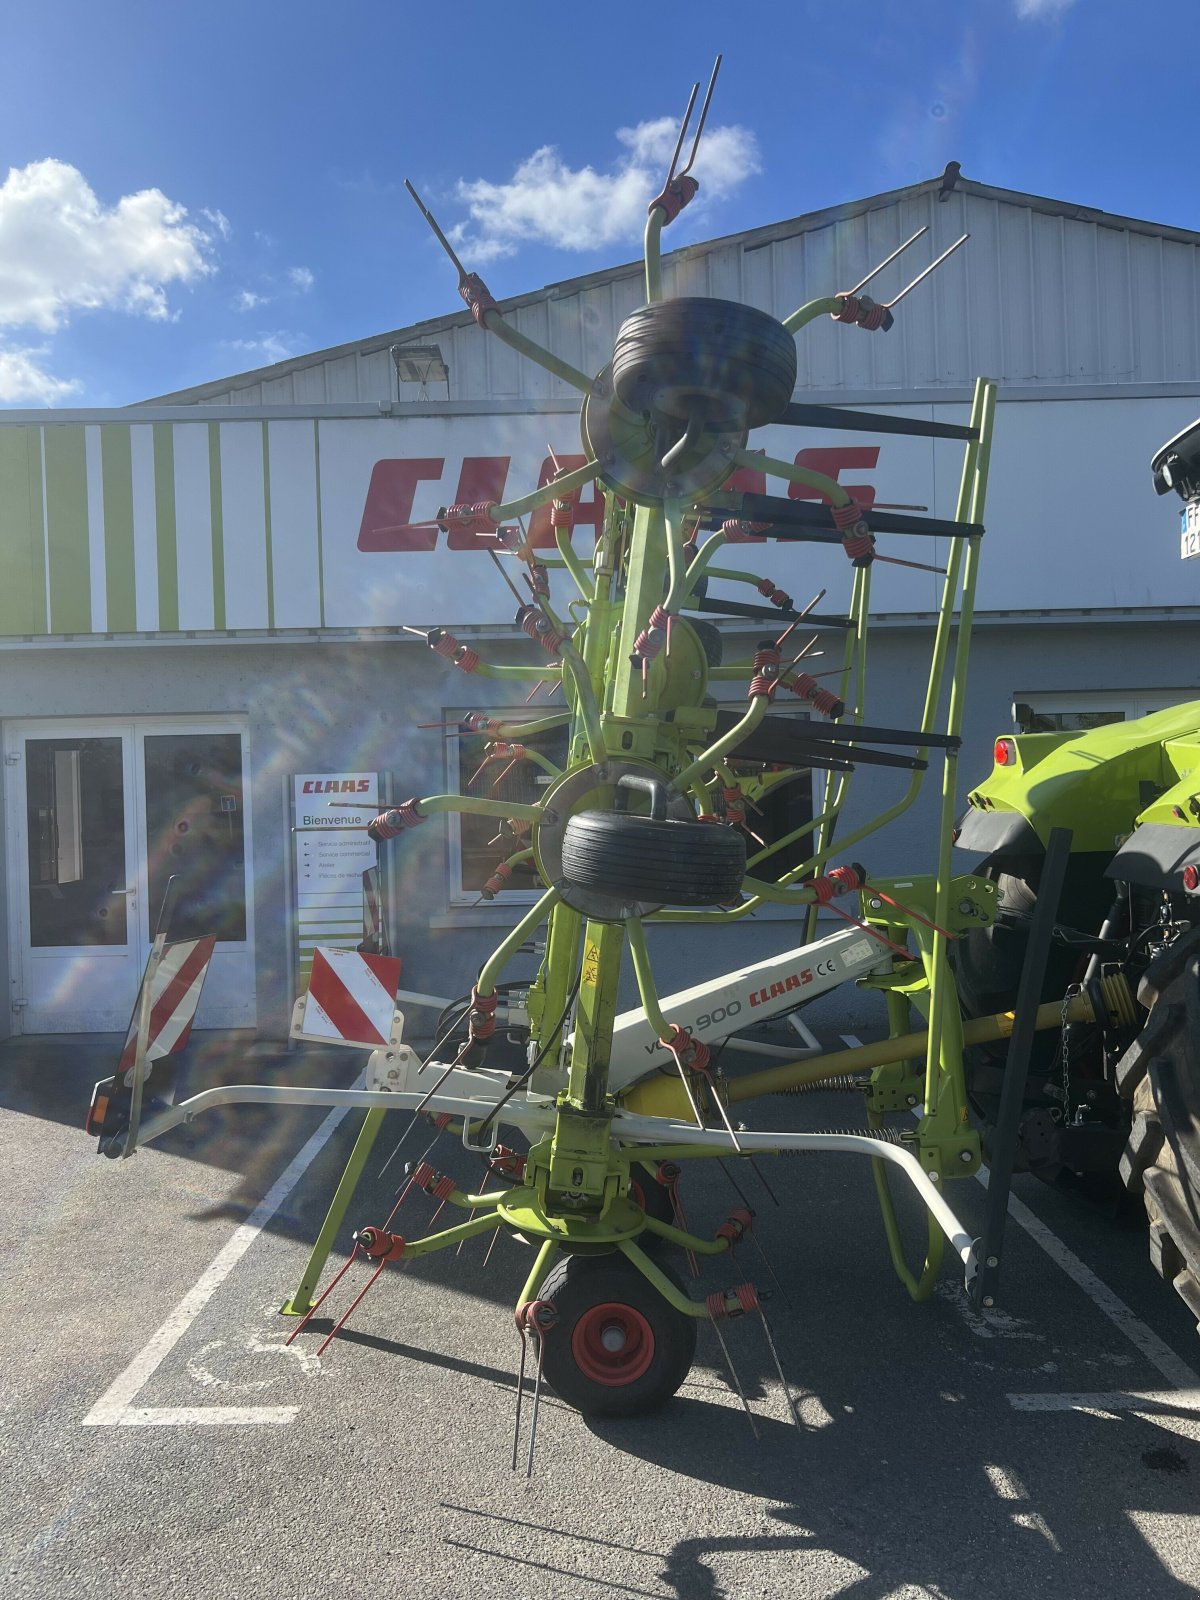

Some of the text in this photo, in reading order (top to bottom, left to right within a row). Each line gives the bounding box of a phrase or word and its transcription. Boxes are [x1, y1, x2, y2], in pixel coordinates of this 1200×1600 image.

[302, 780, 370, 794] CLAAS
[303, 816, 362, 825] Bienvenue
[696, 1000, 742, 1032] 900
[749, 968, 814, 1008] CLAAS
